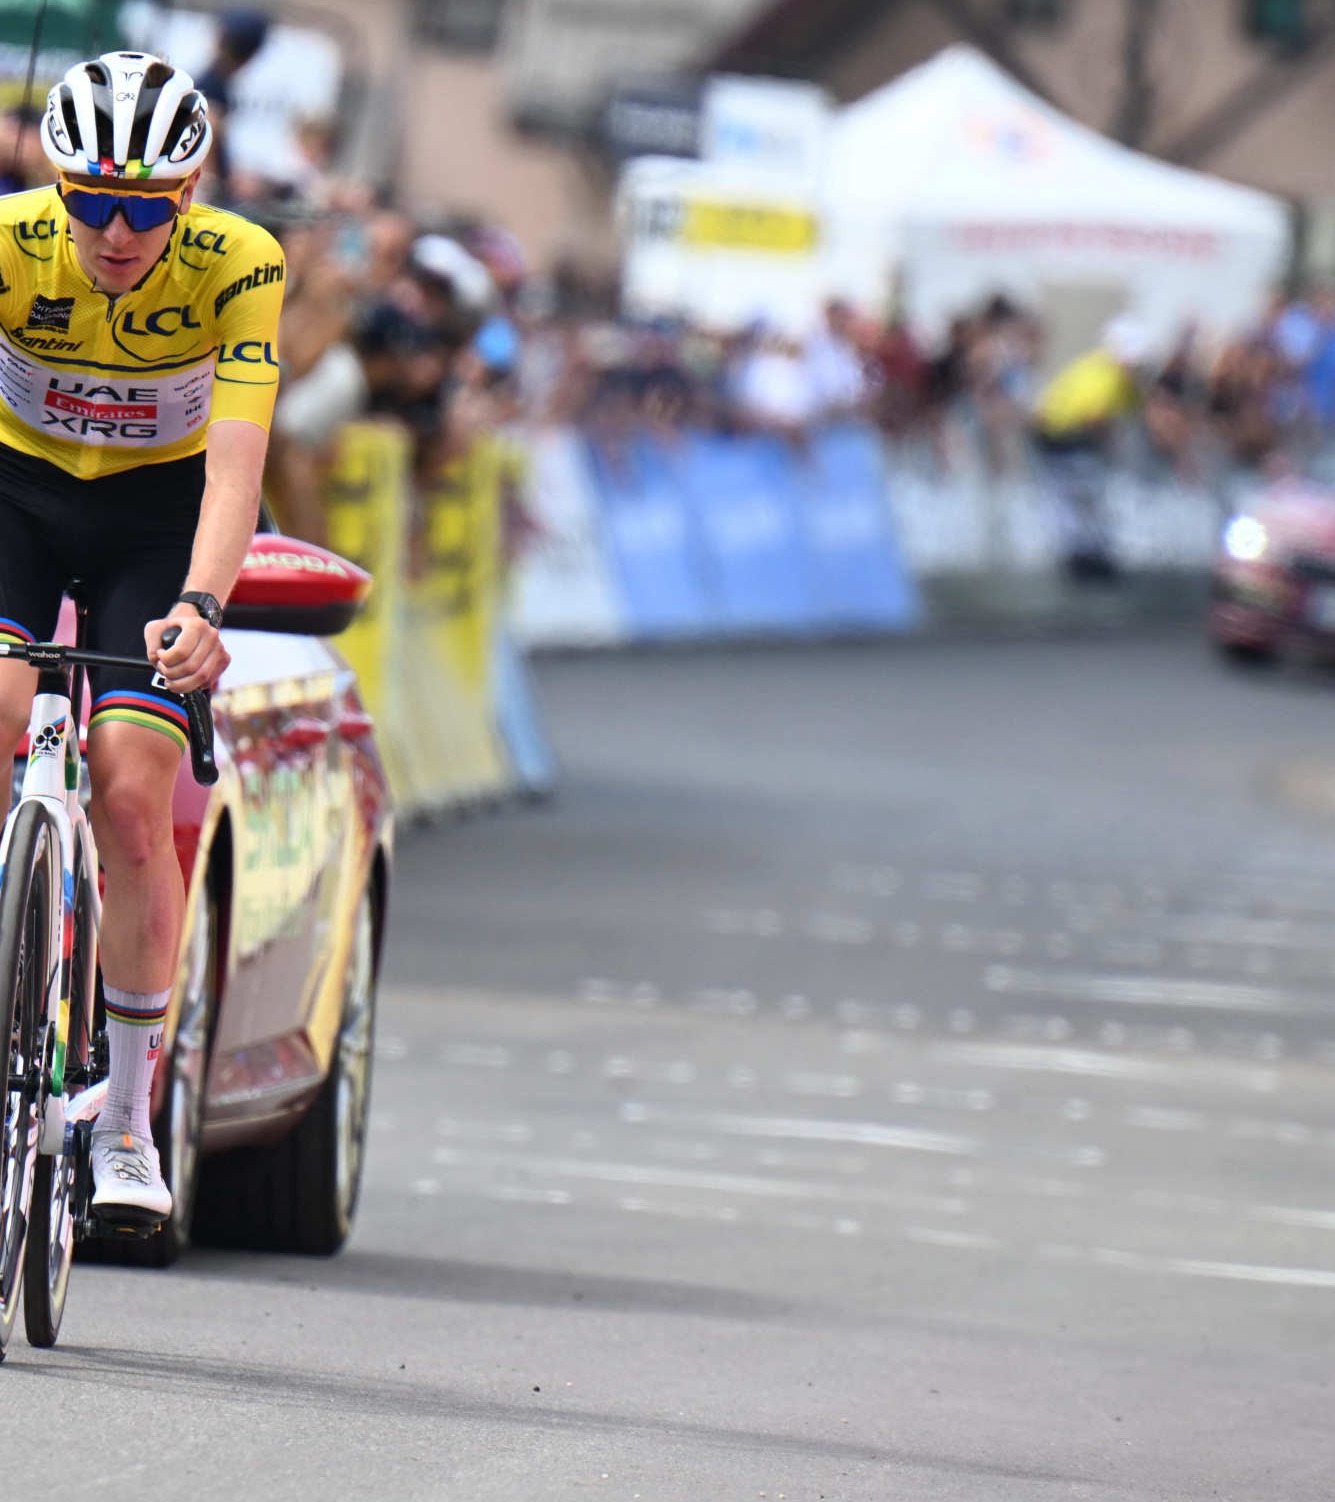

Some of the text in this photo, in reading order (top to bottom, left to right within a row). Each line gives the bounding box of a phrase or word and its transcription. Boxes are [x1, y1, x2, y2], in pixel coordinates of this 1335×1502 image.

[19, 219, 59, 241] LCL
[181, 227, 227, 255] LCL
[121, 304, 202, 337] LCL
[218, 340, 280, 368] LCL
[48, 377, 159, 403] UAE
[55, 396, 147, 421] Emirates
[41, 409, 158, 439] XRG
